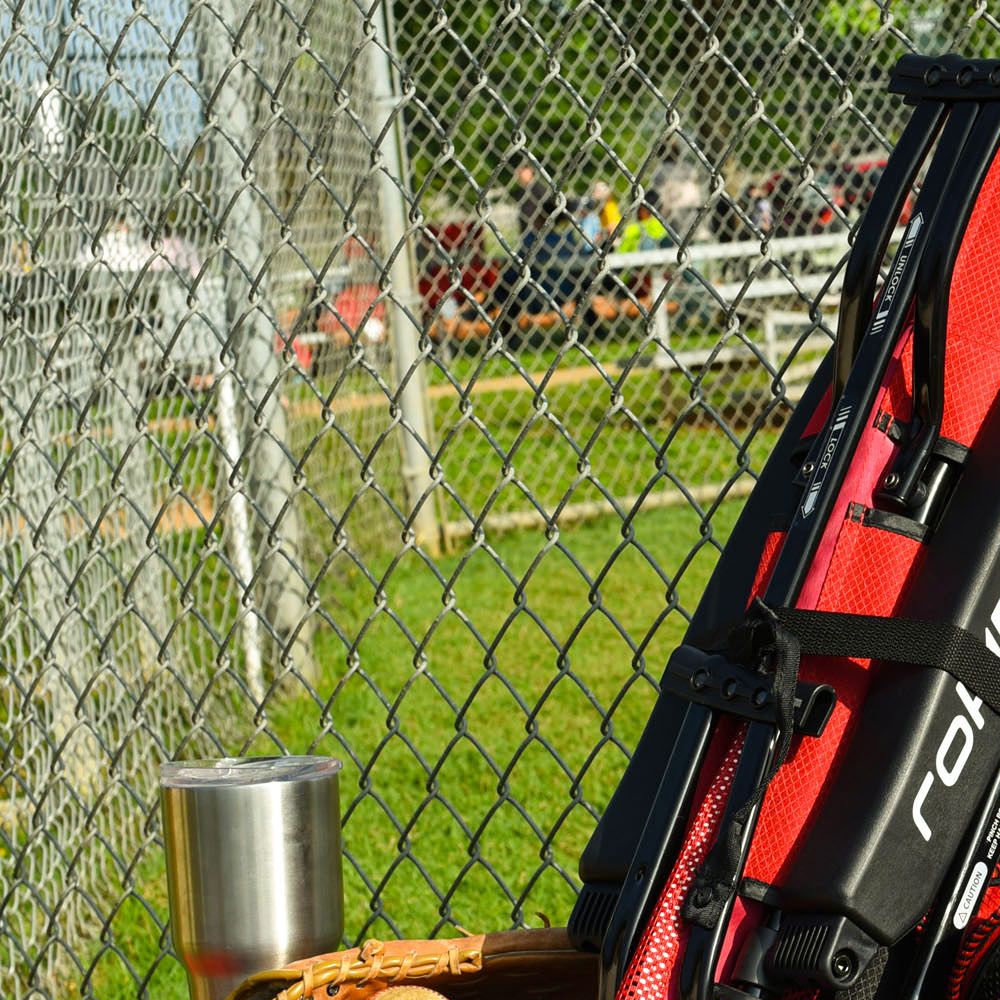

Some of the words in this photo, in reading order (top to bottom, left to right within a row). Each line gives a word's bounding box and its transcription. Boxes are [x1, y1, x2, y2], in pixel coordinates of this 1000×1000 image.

[885, 255, 907, 301] UNLOCK
[820, 438, 837, 469] LOCK
[986, 819, 1000, 843] PINCH
[987, 838, 998, 860] KEEP
[963, 871, 983, 910] CAUTION
